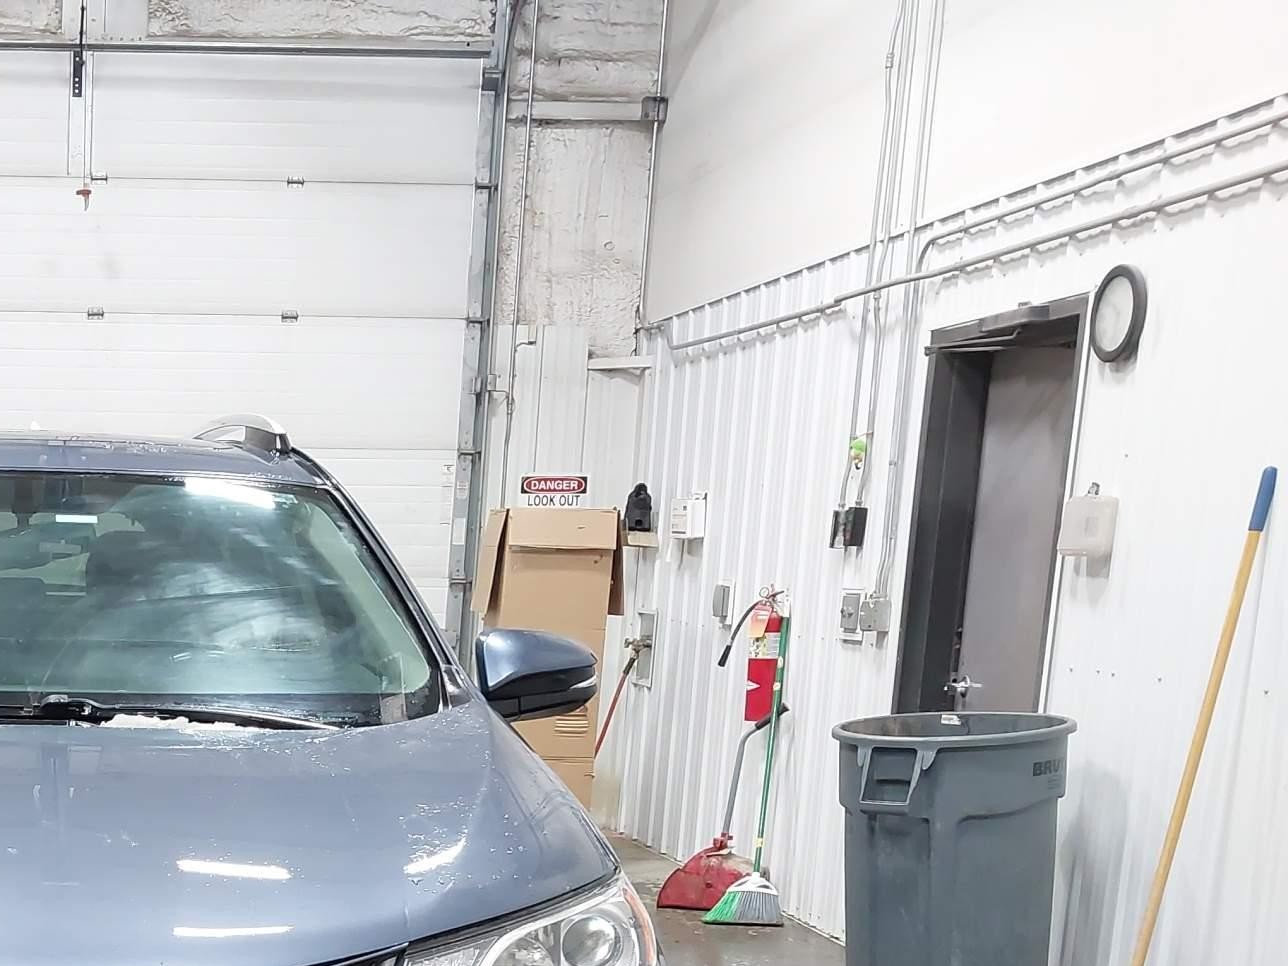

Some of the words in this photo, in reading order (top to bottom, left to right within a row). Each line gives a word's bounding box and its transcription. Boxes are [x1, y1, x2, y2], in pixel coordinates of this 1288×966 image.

[530, 480, 579, 491] DANGER
[527, 494, 556, 507] LOOK
[559, 494, 581, 507] OUT
